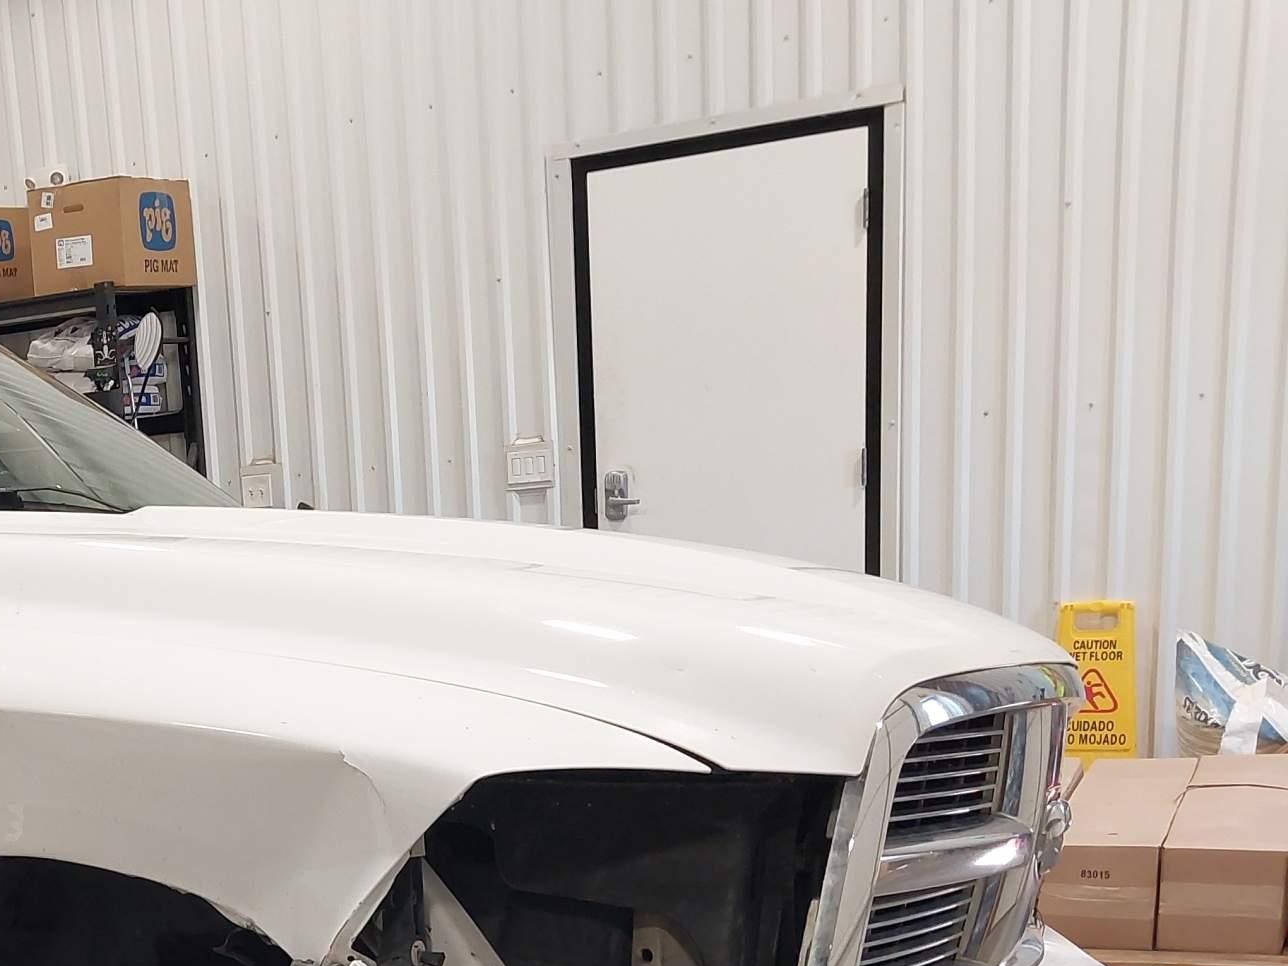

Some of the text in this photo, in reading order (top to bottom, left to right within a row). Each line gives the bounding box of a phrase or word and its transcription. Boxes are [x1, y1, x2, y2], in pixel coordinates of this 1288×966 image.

[144, 259, 179, 273] PIG MAT
[2, 267, 18, 278] MAT
[1073, 640, 1117, 651] CAUTION
[1089, 651, 1123, 661] FLOOR
[1078, 734, 1127, 746] MOJADO
